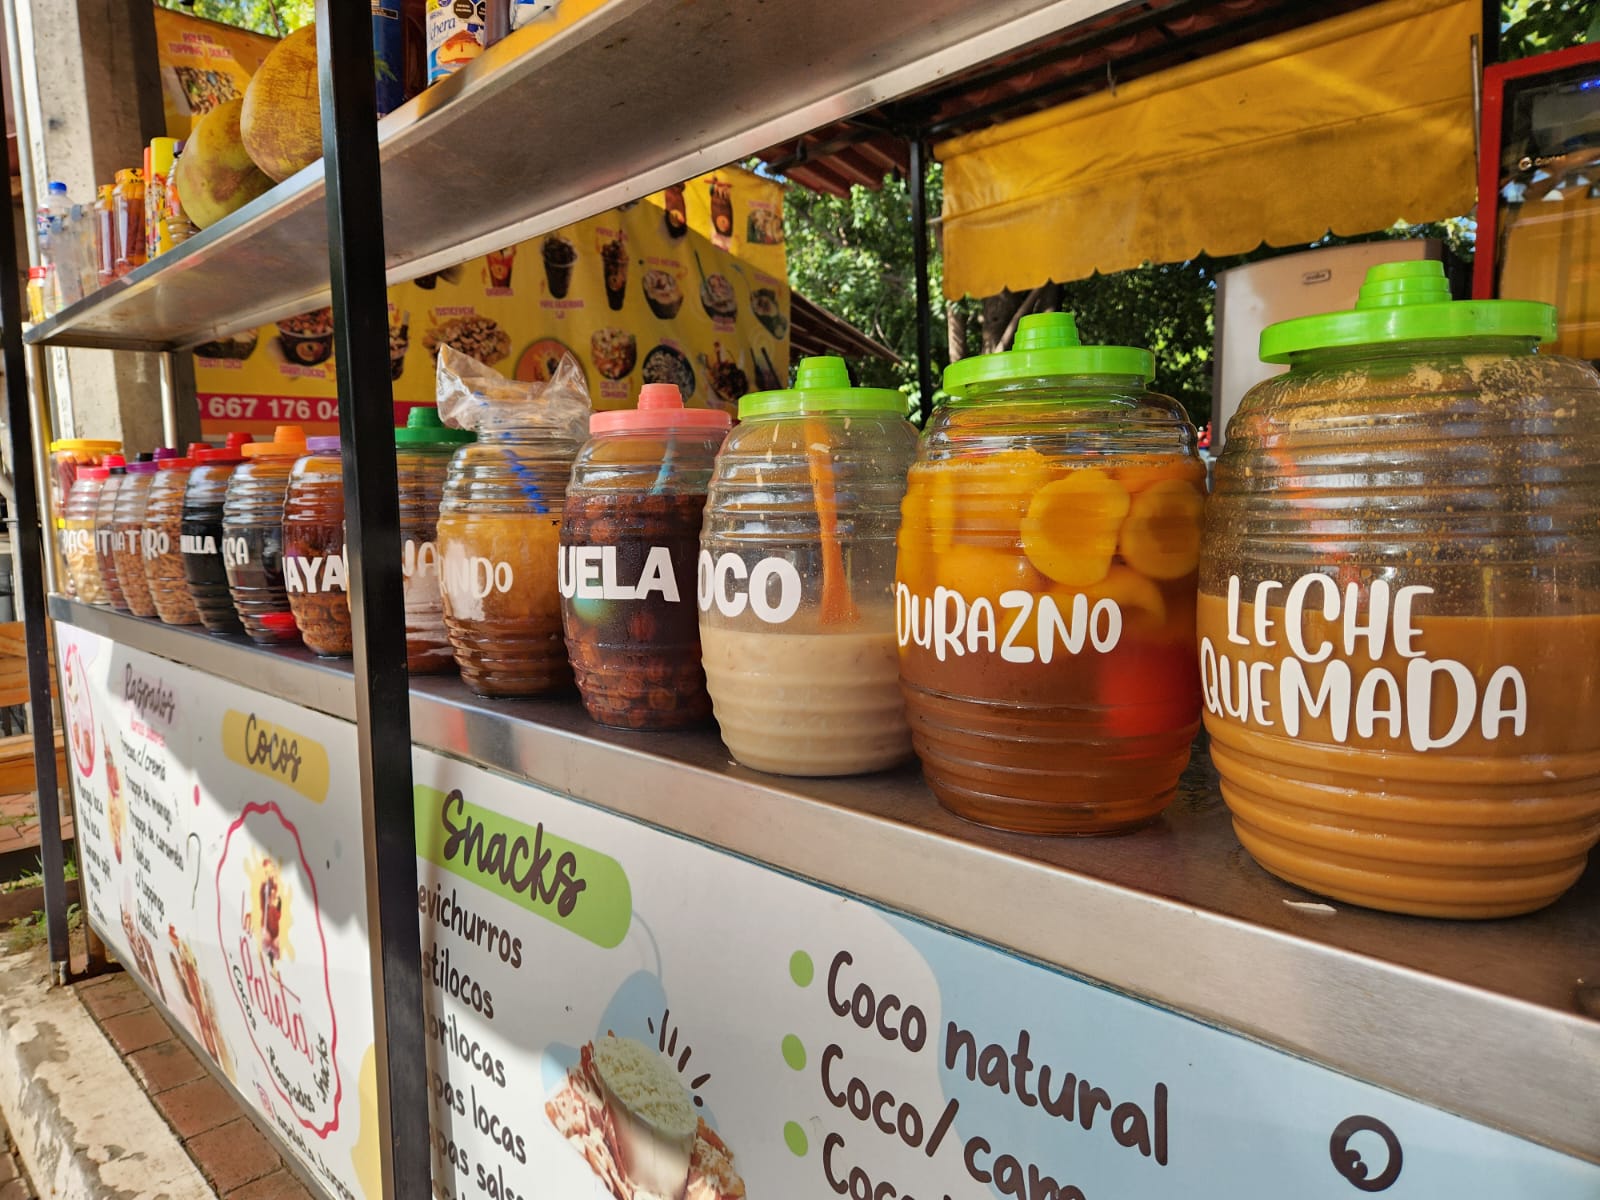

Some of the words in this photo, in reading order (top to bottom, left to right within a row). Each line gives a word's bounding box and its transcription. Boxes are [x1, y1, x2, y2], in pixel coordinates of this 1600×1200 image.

[208, 397, 258, 418] 667
[267, 398, 311, 420] 176
[282, 555, 347, 593] AYA
[558, 543, 680, 602] UELA
[897, 582, 1122, 664] DURAZNO
[1227, 573, 1434, 663] LECHE
[1201, 637, 1527, 752] QUEMADA
[245, 712, 302, 783] Cocos
[441, 789, 587, 918] Snacks
[827, 950, 927, 1052] Coco
[944, 1020, 1168, 1167] natural
[471, 1085, 527, 1164] locas
